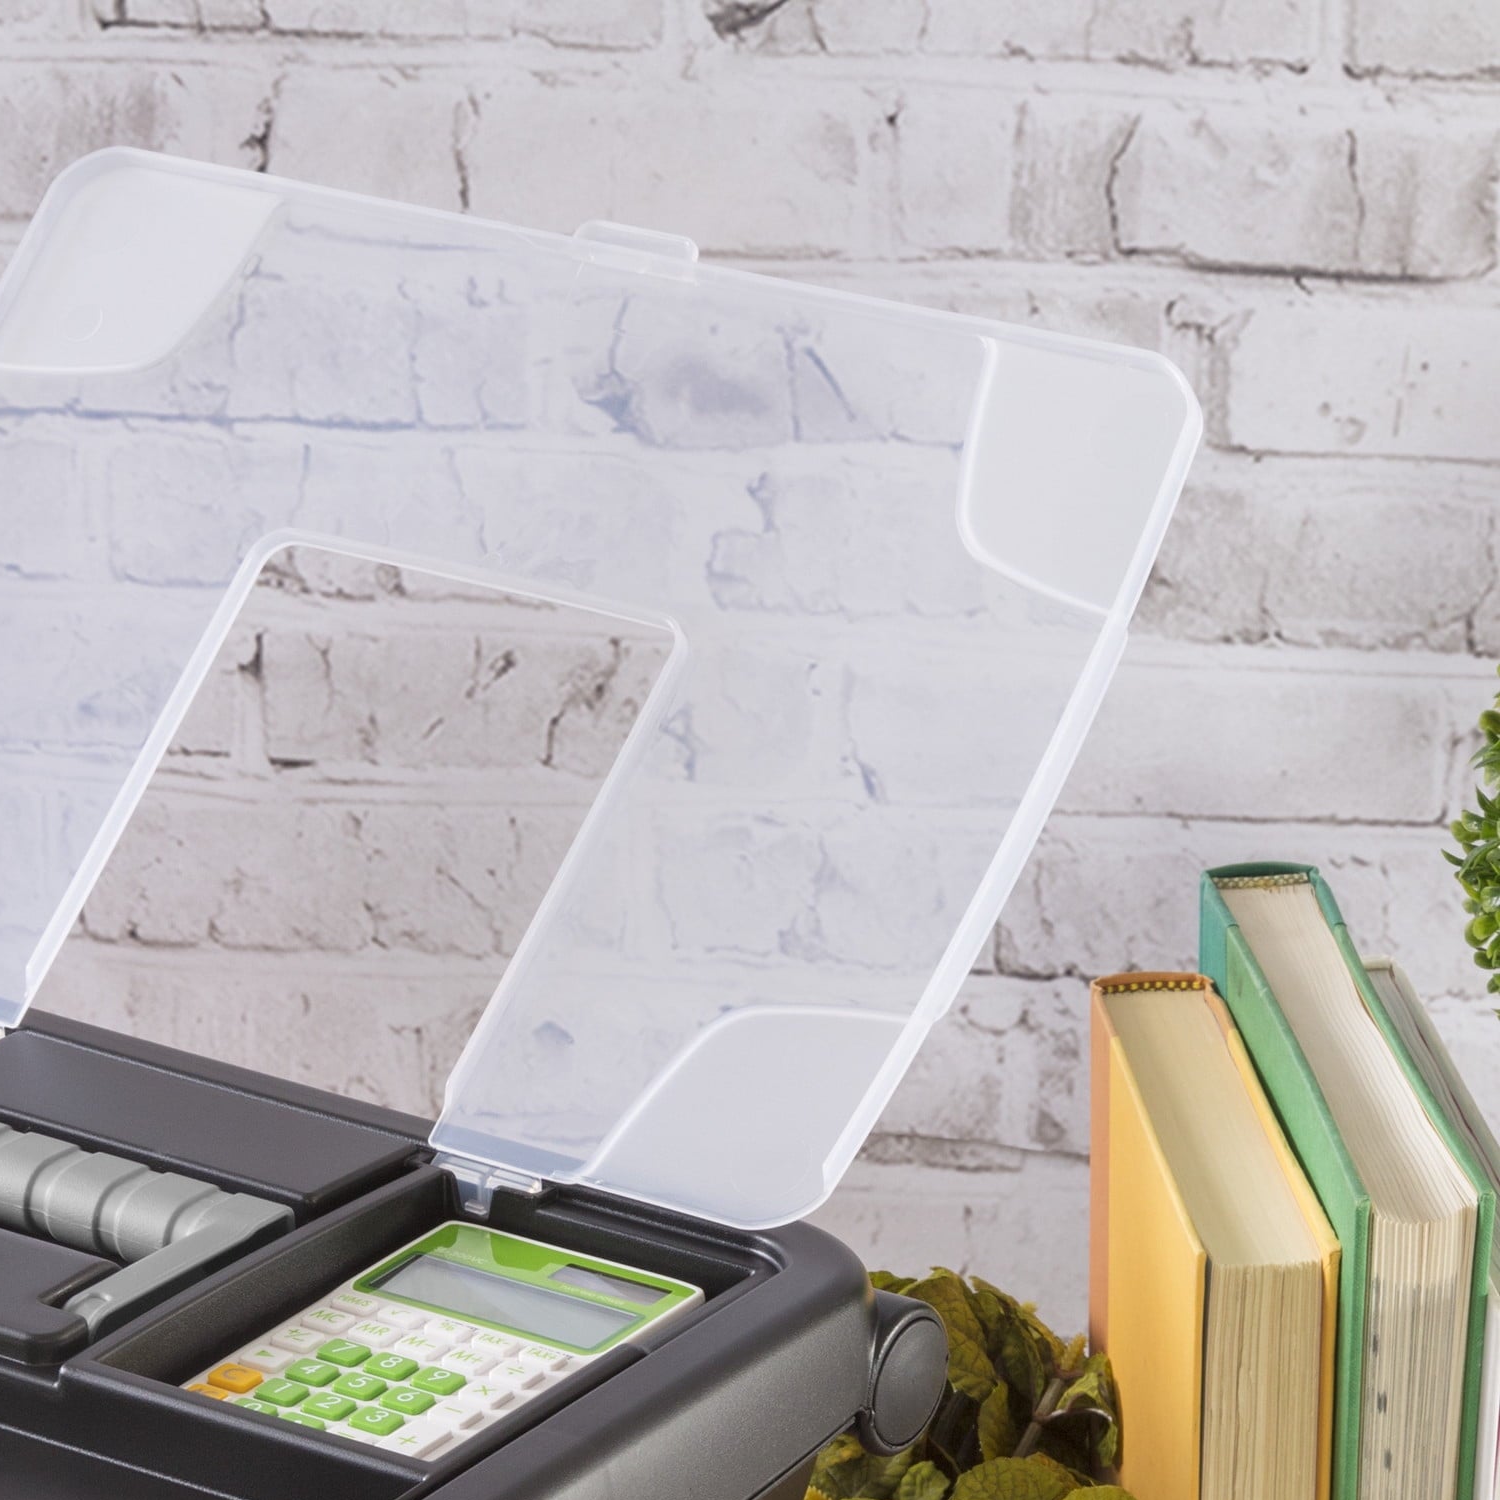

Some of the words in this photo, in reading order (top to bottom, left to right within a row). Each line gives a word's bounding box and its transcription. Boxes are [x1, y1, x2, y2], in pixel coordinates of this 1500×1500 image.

[309, 1309, 346, 1324] MC
[359, 1322, 391, 1337] MR
[222, 1367, 249, 1381] C
[331, 1342, 358, 1353] 7
[380, 1356, 404, 1369] 8
[427, 1370, 451, 1382] 9
[273, 1382, 294, 1394] 1
[315, 1397, 342, 1410] 2
[365, 1410, 390, 1424] 3
[301, 1364, 324, 1375] 4
[348, 1376, 373, 1388] 5
[396, 1390, 421, 1403] 6
